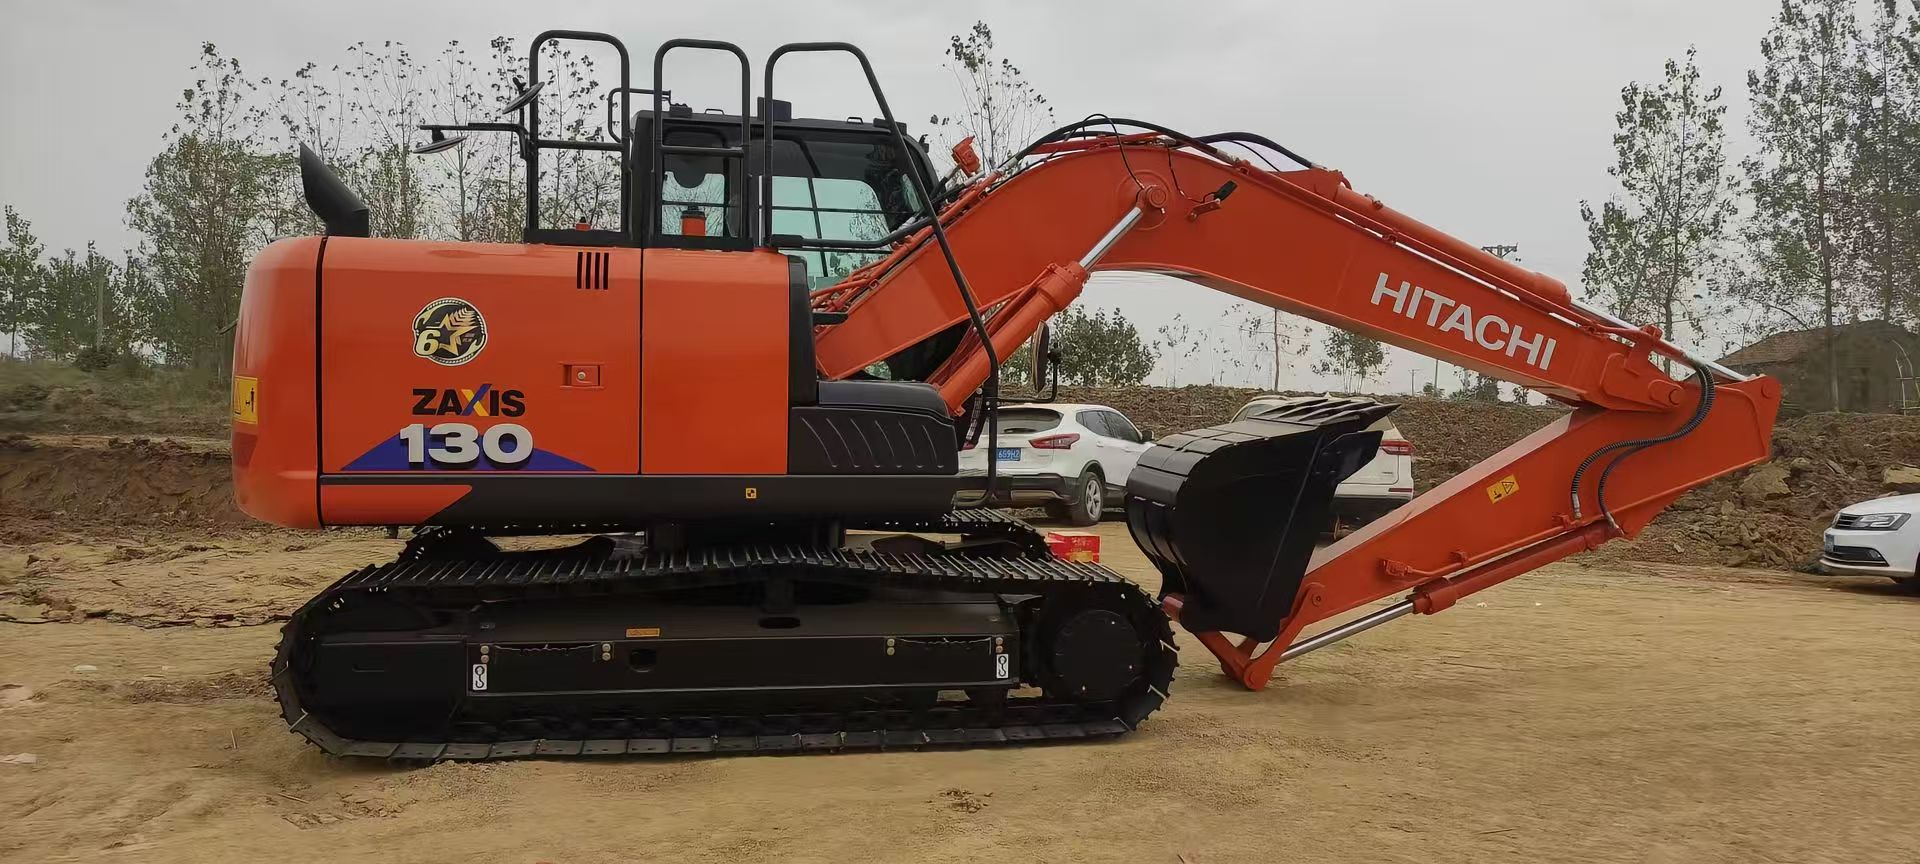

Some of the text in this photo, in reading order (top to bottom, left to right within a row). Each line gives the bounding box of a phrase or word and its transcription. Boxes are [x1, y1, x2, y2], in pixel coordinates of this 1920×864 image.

[1370, 272, 1557, 371] HITACHI
[415, 329, 441, 356] 6
[412, 383, 526, 417] ZAXIS
[399, 422, 534, 464] 130
